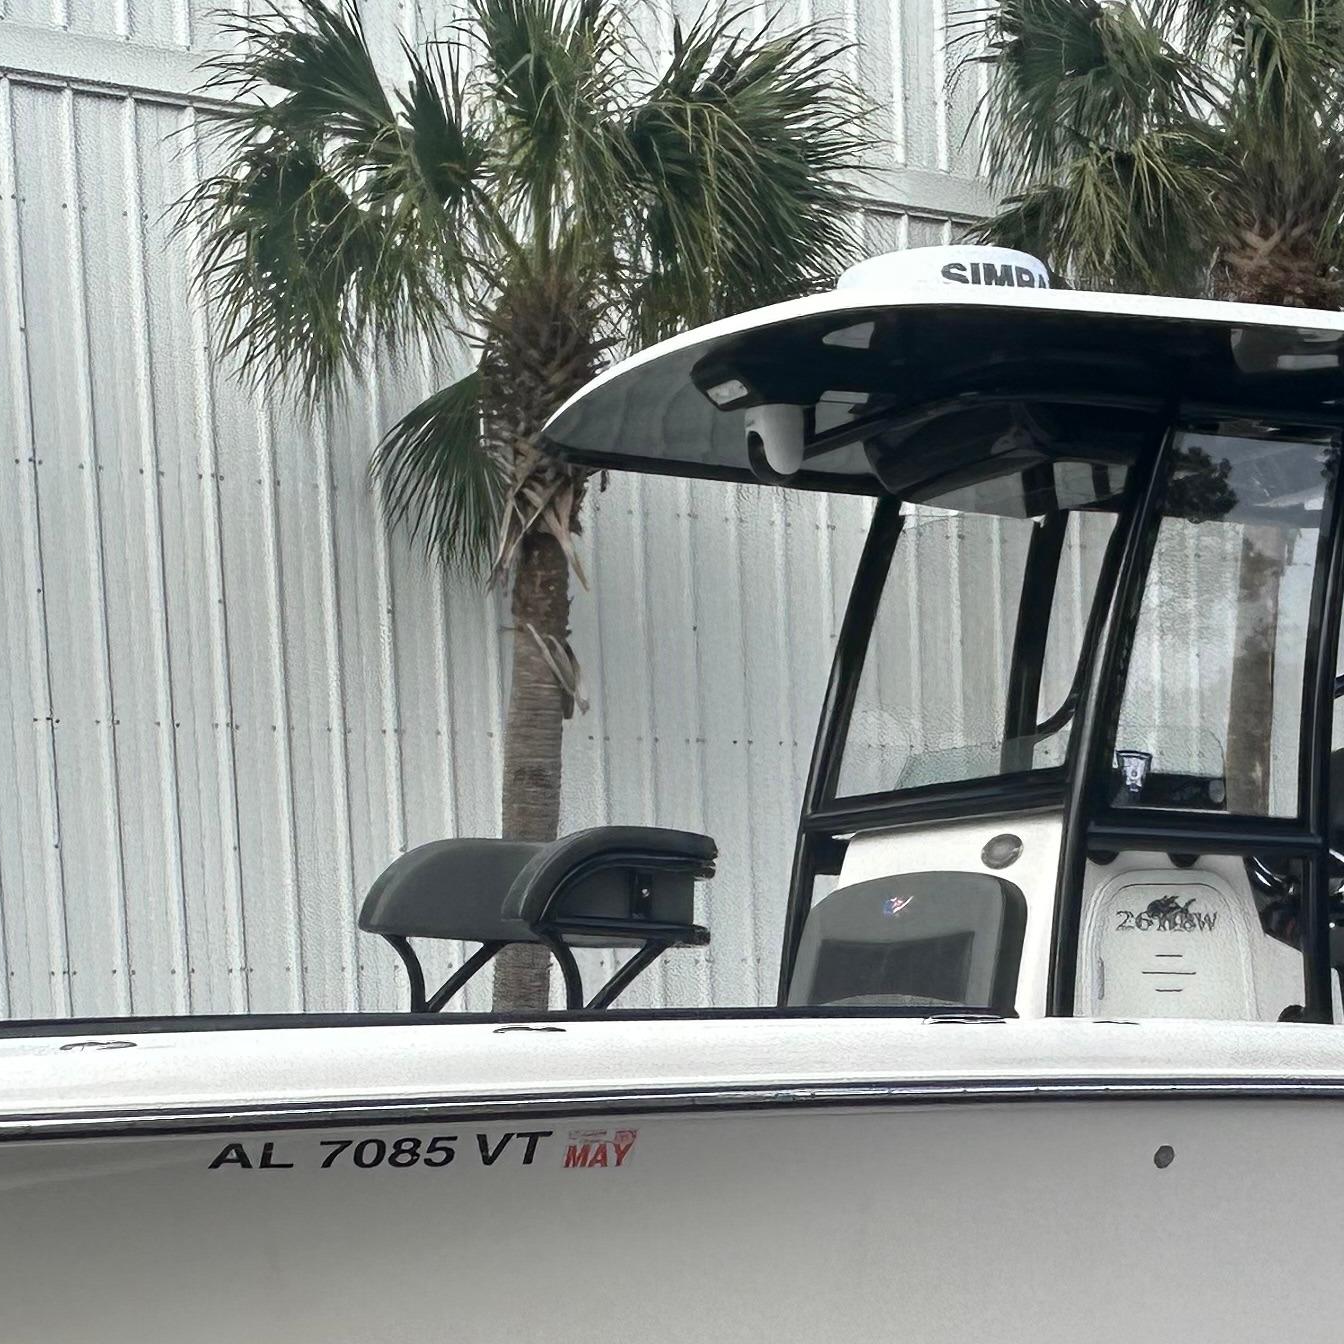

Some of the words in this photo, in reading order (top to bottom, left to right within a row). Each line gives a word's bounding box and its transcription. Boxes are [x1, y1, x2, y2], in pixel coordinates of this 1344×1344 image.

[207, 1142, 294, 1170] AL
[319, 1135, 458, 1169] 7085
[476, 1130, 554, 1167] VT
[564, 1143, 633, 1169] MAY
